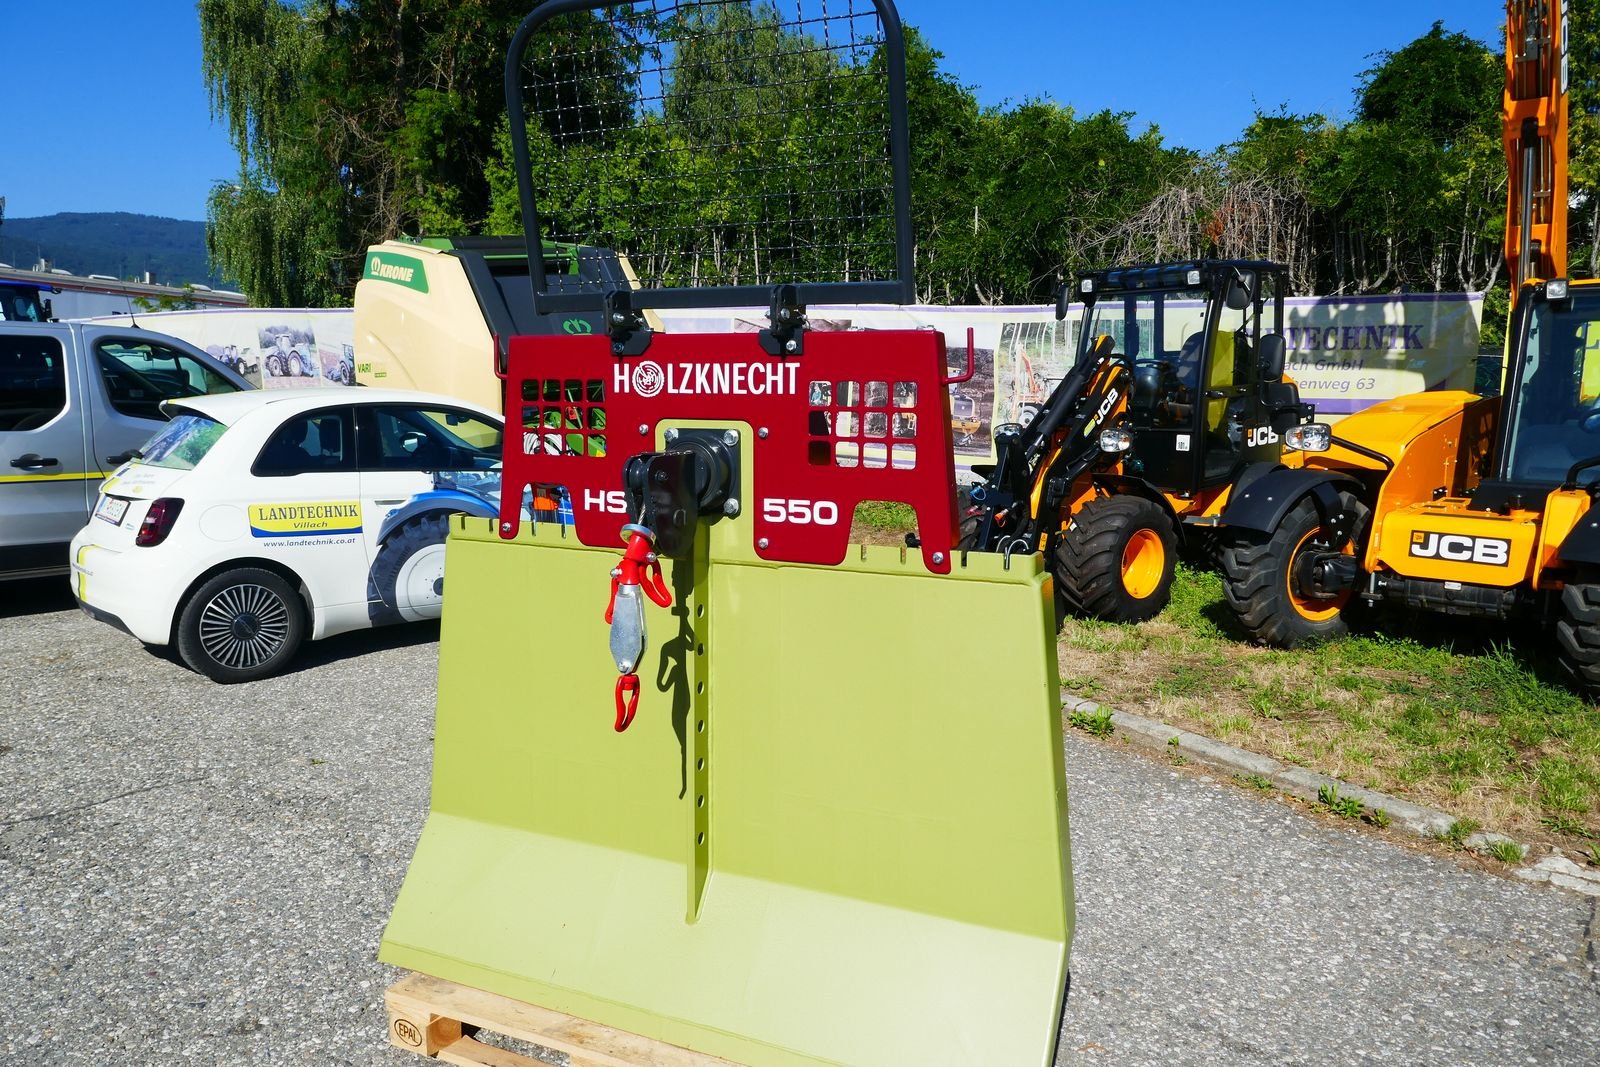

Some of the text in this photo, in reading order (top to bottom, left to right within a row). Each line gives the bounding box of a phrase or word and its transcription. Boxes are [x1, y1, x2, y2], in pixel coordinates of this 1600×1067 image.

[380, 264, 413, 282] KRONE
[1246, 324, 1425, 351] TECHNIK
[1284, 358, 1364, 371] ach GmbH
[613, 360, 801, 397] HOLZKNECHT
[1356, 377, 1376, 390] 63
[1095, 388, 1119, 425] JCB
[1247, 426, 1279, 448] JCB
[258, 504, 359, 521] LANDTECHNIK
[584, 488, 839, 526] HS 550
[293, 521, 328, 529] Villach
[263, 537, 356, 547] www.landtechnik.co.at
[1411, 533, 1508, 564] JCB
[398, 1022, 419, 1044] EPAL
